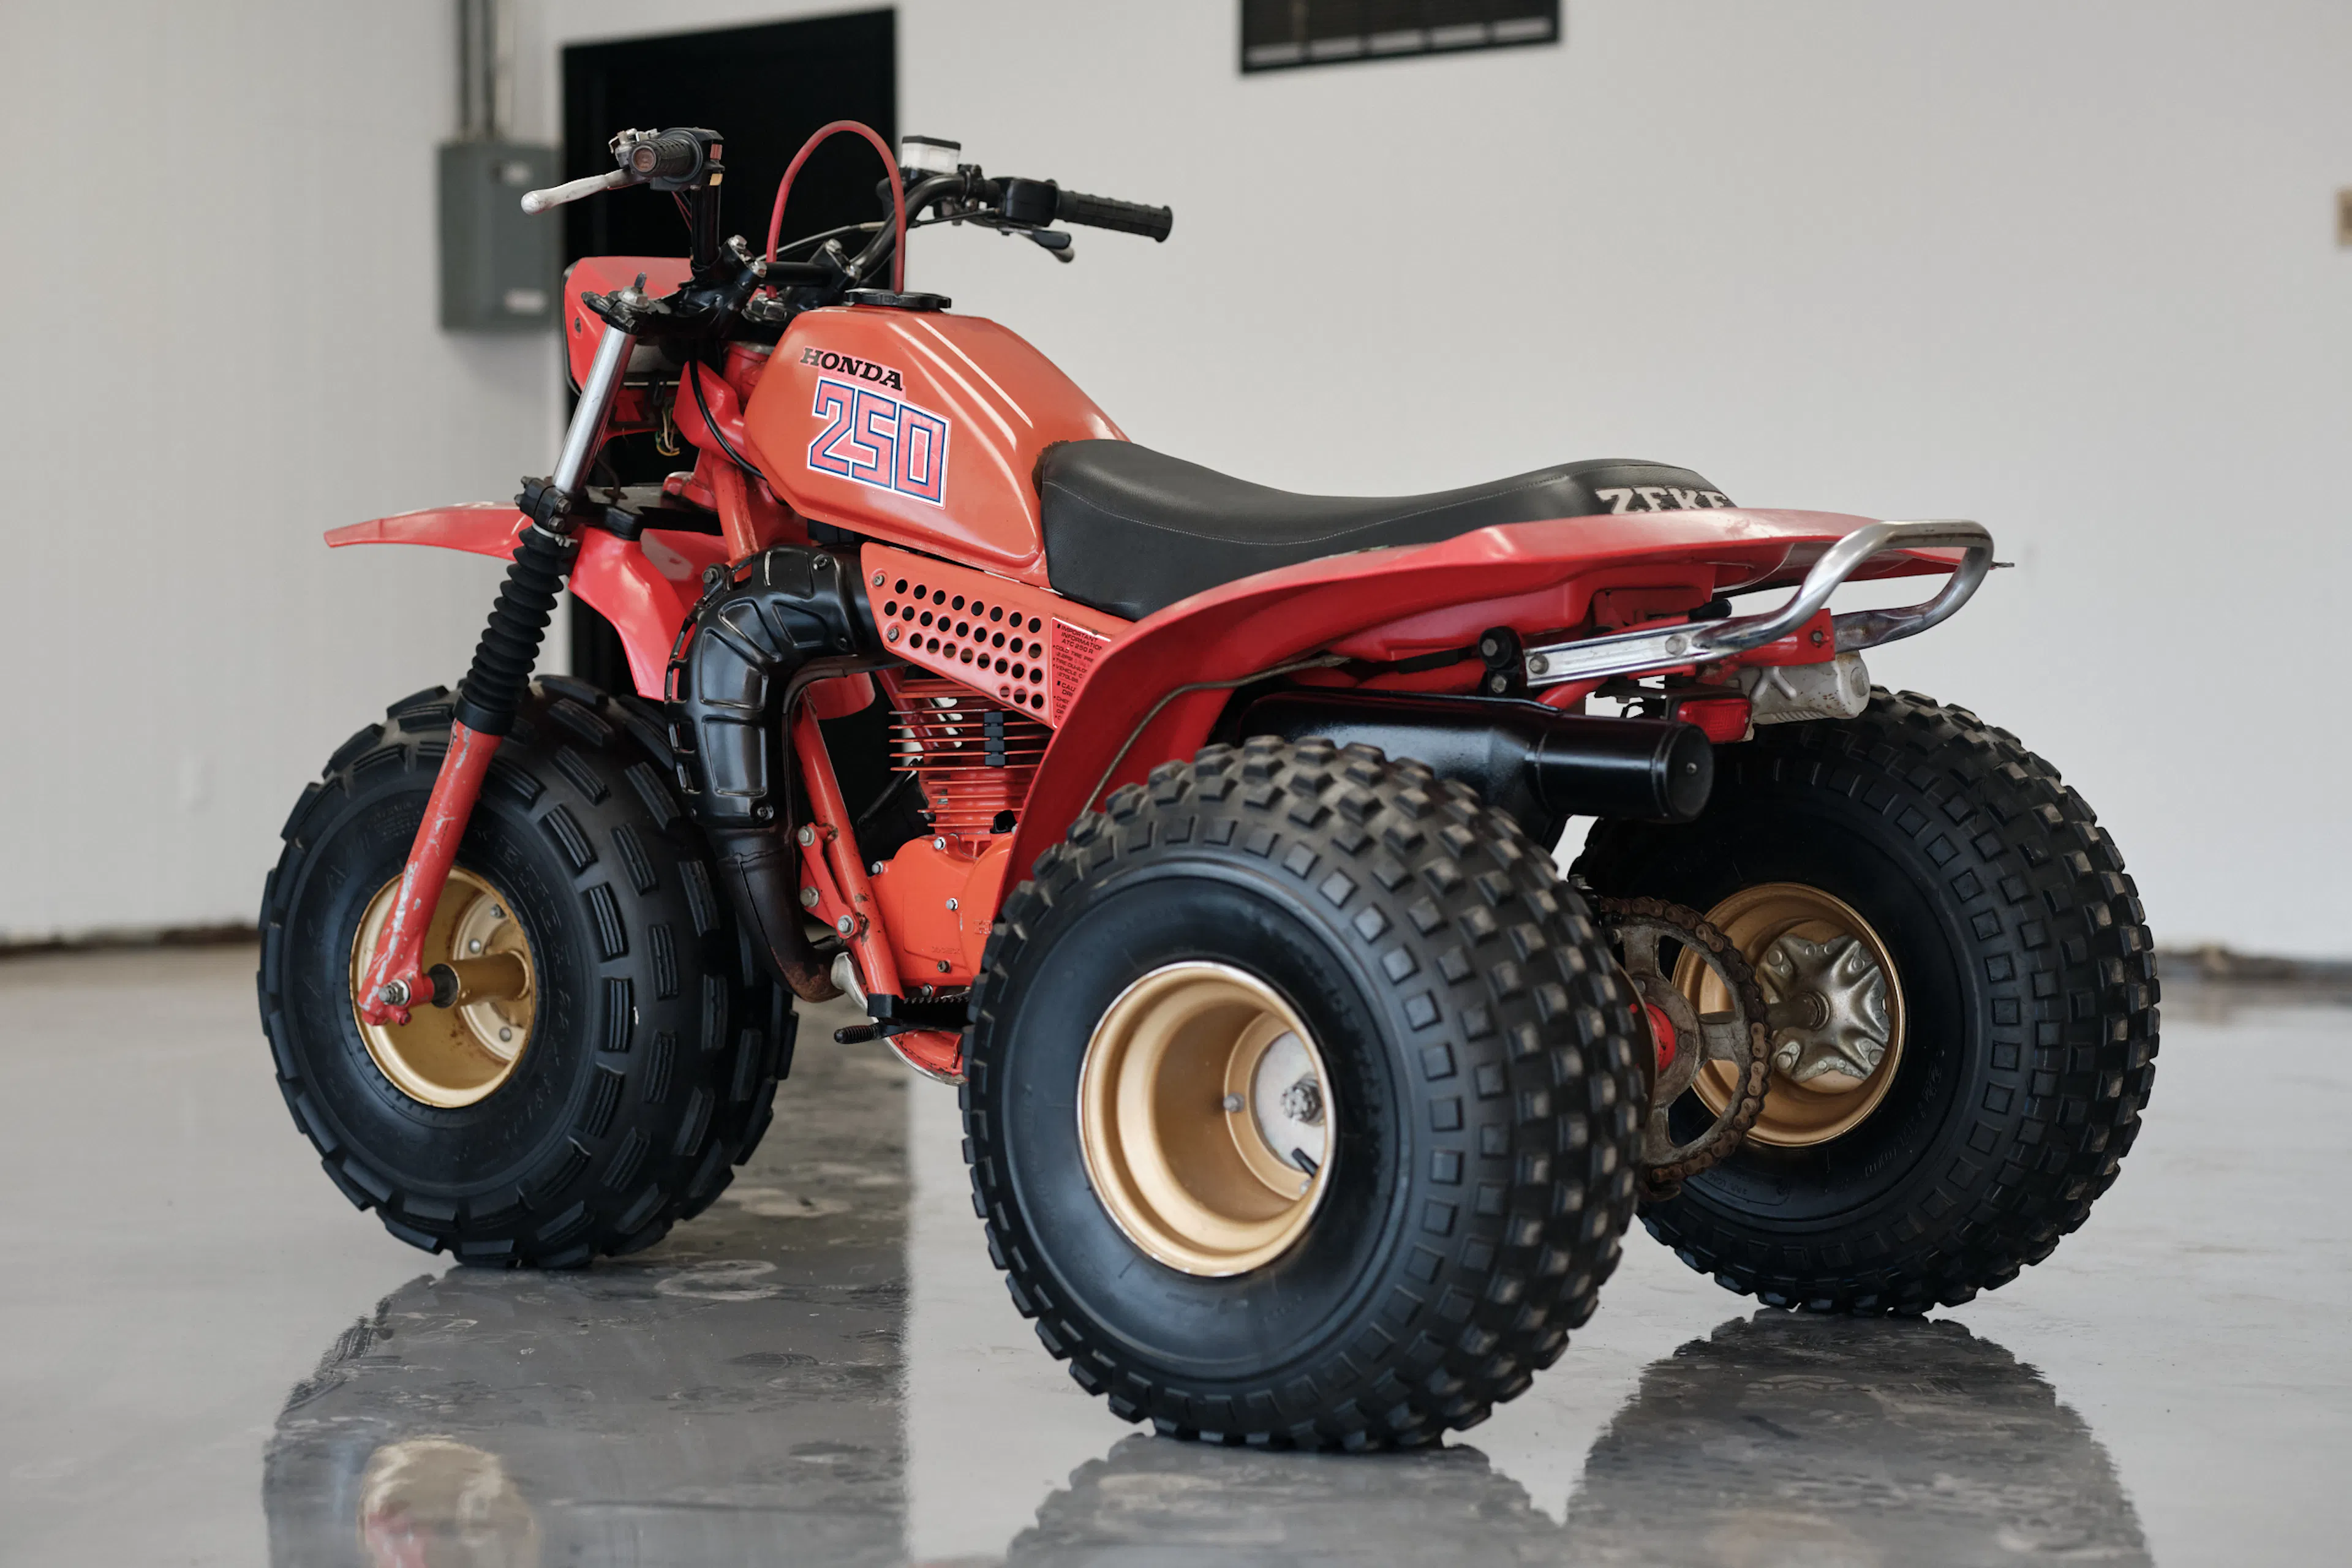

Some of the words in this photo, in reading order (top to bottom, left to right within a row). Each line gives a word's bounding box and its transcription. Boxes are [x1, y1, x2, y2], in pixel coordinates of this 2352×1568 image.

[800, 347, 903, 391] HONDA
[807, 375, 951, 508] 250
[1061, 625, 1098, 643] IMPORTANT
[1055, 645, 1069, 654] COLD
[1071, 650, 1082, 659] TIRE
[1061, 638, 1074, 647] ATC
[1075, 642, 1088, 652] 250
[1056, 663, 1077, 676] VEHICLE
